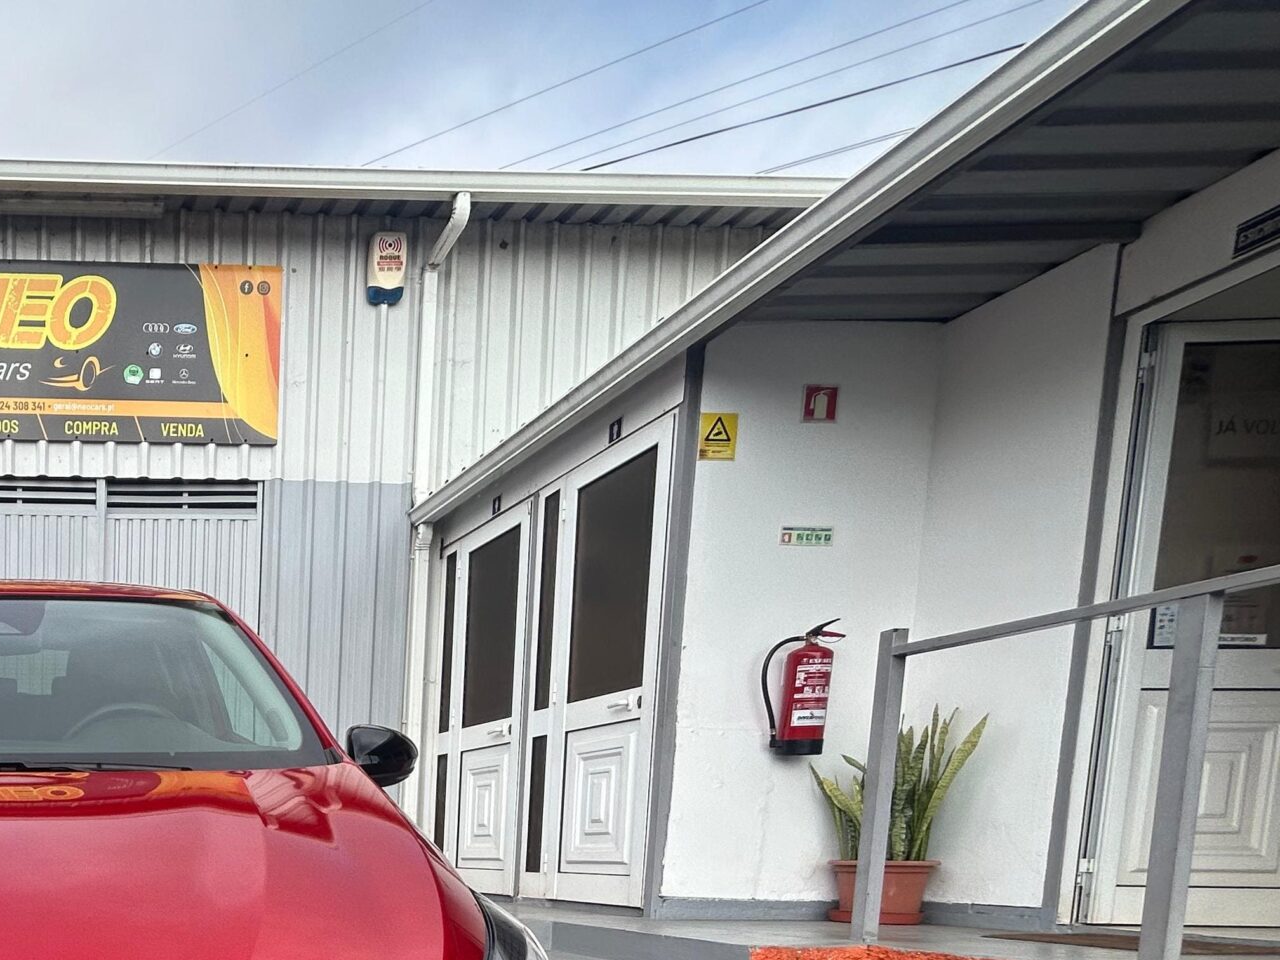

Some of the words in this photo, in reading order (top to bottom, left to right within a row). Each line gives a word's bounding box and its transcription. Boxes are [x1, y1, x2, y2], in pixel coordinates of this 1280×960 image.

[12, 401, 29, 411] 308
[31, 402, 46, 411] 341
[64, 420, 119, 436] COMPRA
[161, 422, 205, 438] VENDA
[1215, 414, 1237, 436] JÁ
